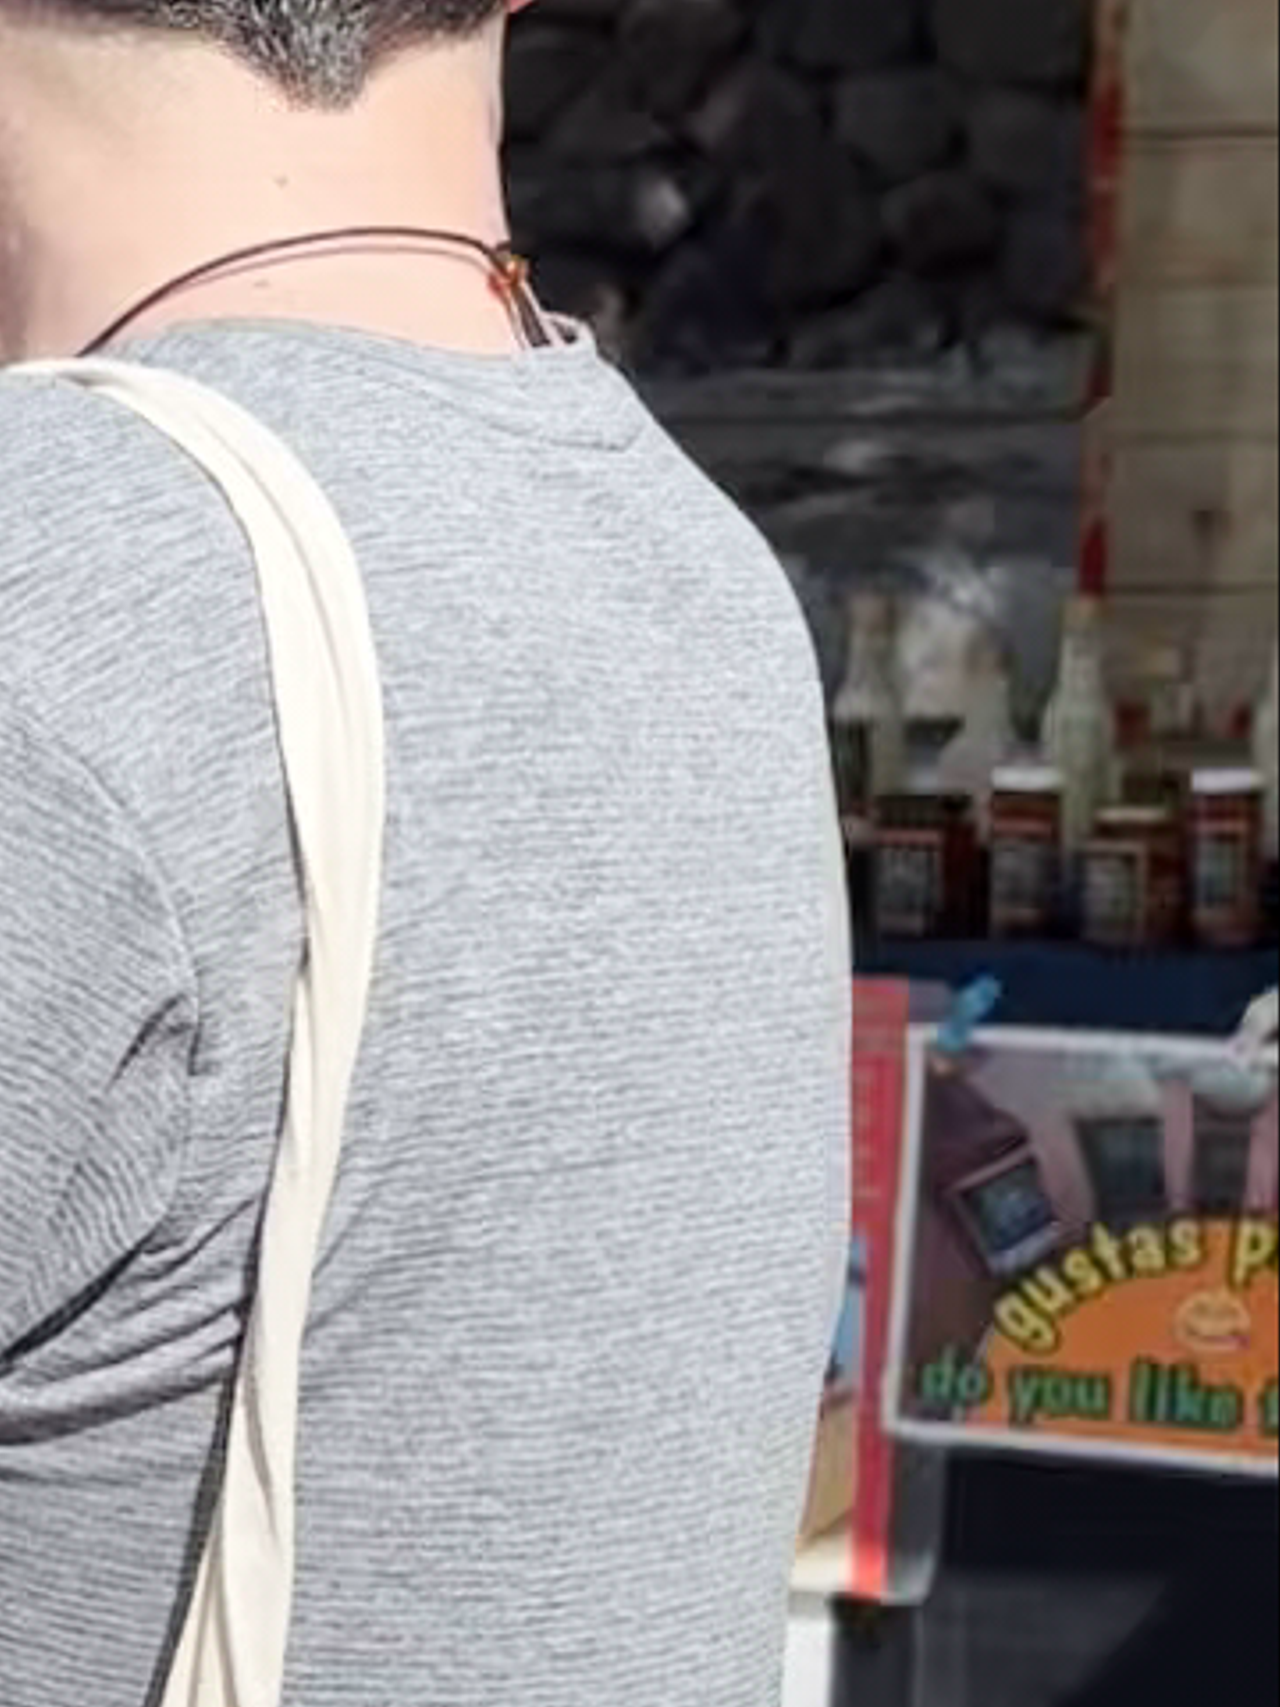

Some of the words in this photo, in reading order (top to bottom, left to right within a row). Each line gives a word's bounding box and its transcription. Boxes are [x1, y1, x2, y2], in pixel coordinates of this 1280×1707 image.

[994, 1219, 1201, 1351] gustas
[921, 1343, 988, 1404] do
[1011, 1368, 1108, 1421] you
[1131, 1359, 1241, 1427] like
